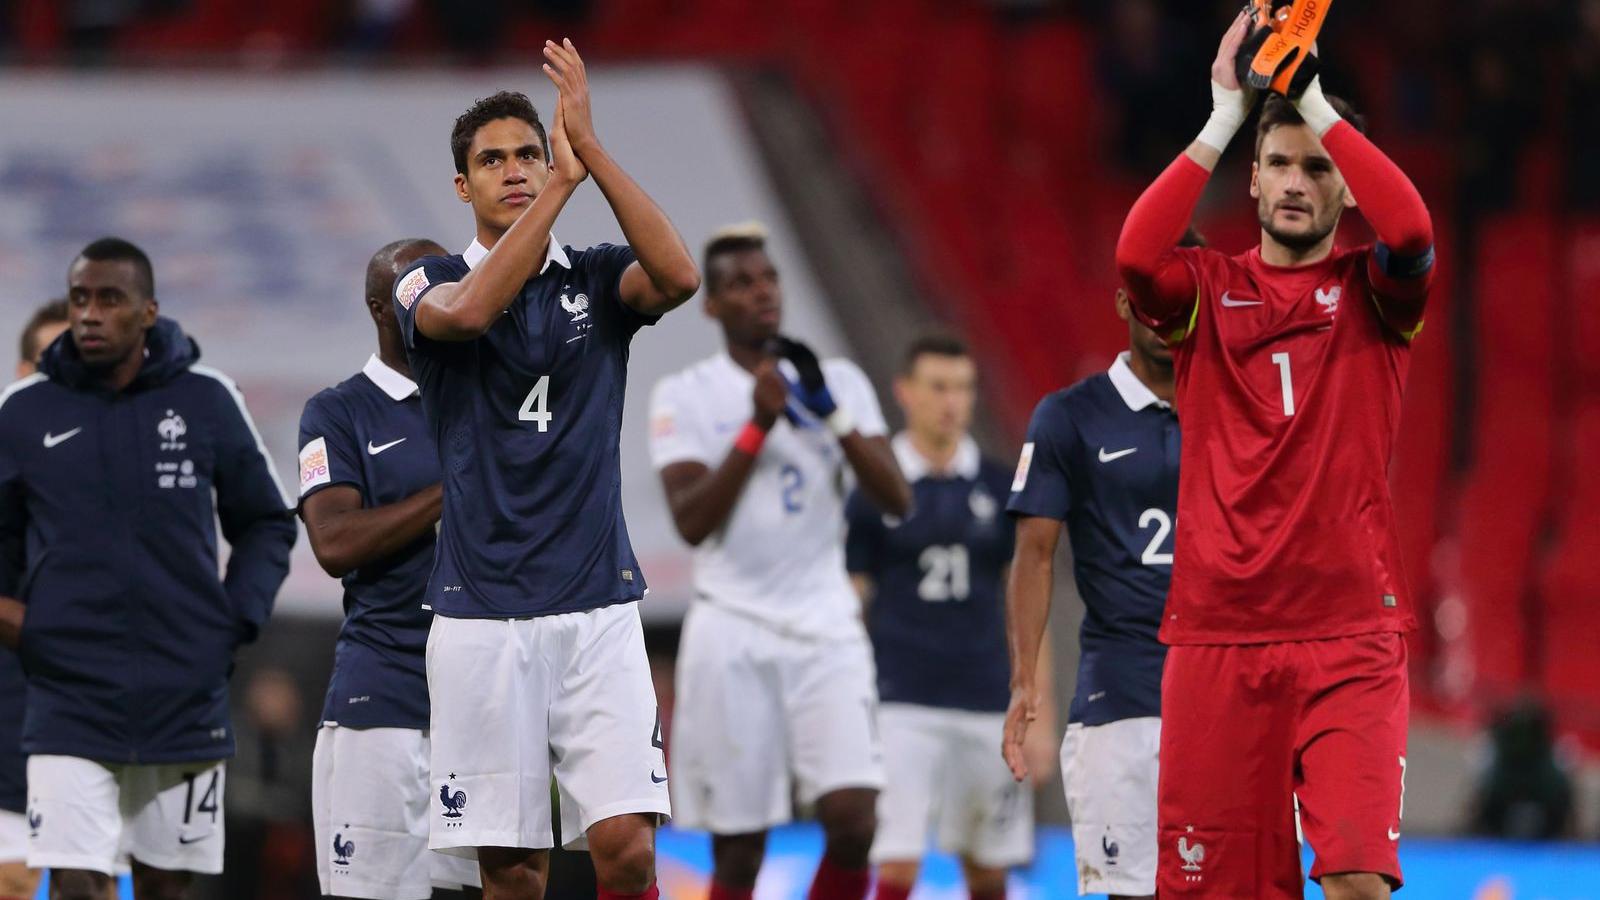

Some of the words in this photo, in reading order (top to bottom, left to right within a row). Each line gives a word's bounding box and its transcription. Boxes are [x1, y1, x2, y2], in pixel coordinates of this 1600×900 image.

[1291, 1, 1316, 38] Hugo
[518, 375, 552, 432] 4
[1272, 352, 1295, 416] 1
[780, 464, 805, 514] 2
[1138, 508, 1178, 565] 2
[918, 545, 970, 601] 21
[182, 771, 218, 824] 14
